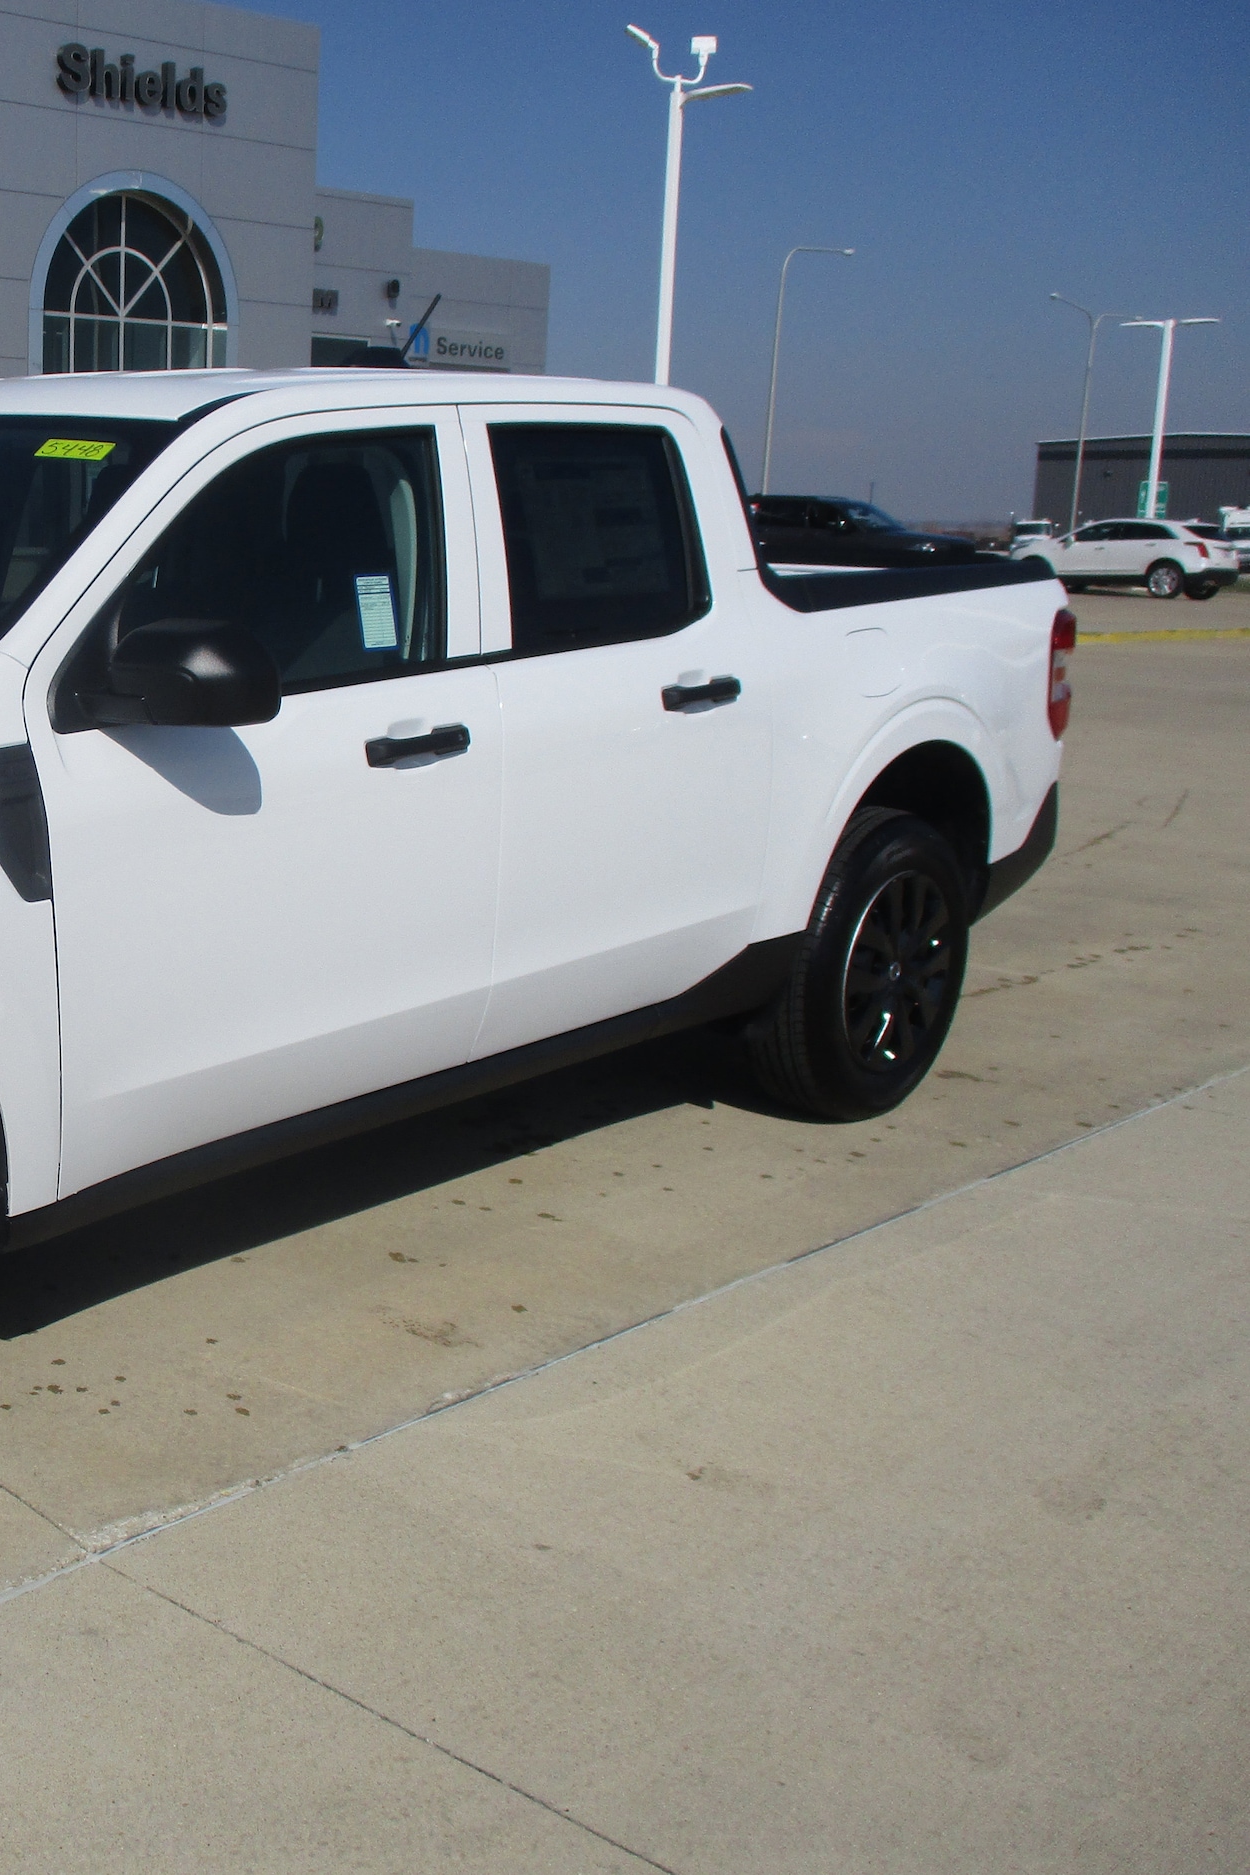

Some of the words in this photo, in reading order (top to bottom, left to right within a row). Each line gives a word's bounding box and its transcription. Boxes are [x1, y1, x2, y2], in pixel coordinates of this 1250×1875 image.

[56, 42, 227, 117] Shields
[436, 336, 504, 360] Service
[41, 442, 104, 457] 5448
